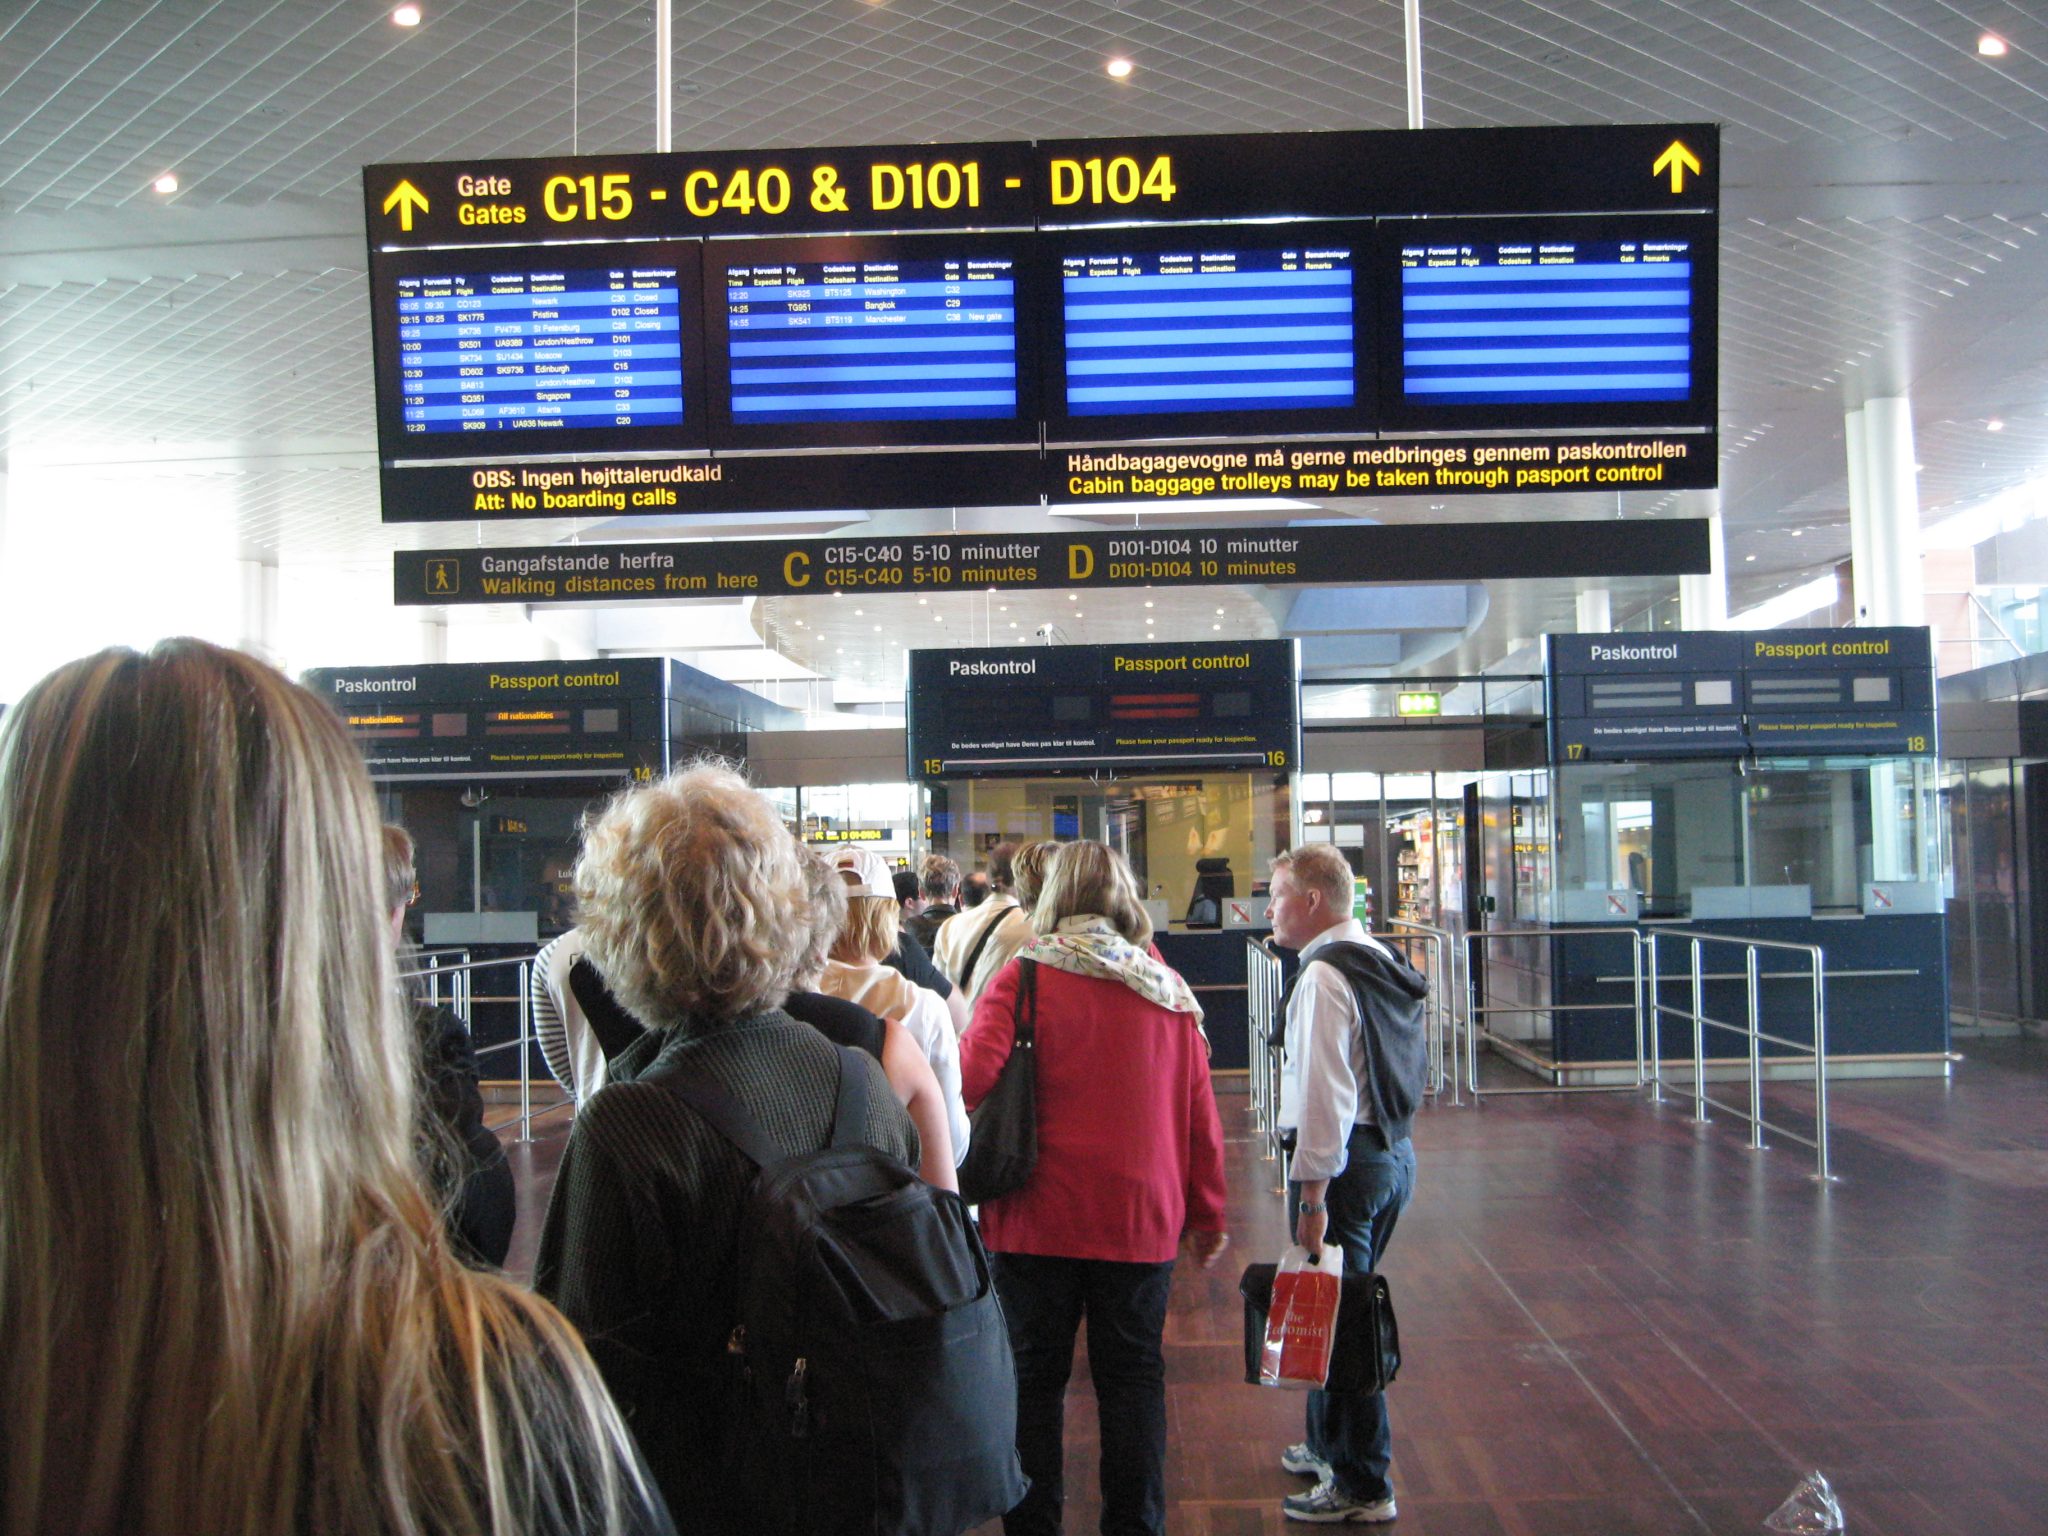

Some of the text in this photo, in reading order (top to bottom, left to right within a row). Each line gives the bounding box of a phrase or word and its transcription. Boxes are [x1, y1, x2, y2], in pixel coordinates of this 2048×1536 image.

[458, 174, 512, 197] Gate
[543, 157, 1175, 223] C15 - C40 & D101 - D104
[460, 202, 526, 226] Gates
[865, 288, 906, 296] Washington
[533, 311, 558, 319] Pristina
[865, 302, 895, 310] Bangkok
[534, 338, 594, 346] London/Heathrow
[535, 365, 570, 374] Edinburgh
[536, 378, 595, 386] London/Heathrow
[537, 393, 570, 401] Singapore
[1069, 442, 1686, 473] Håndbagagevogne må gerne medbringes gennem paskontrollen
[473, 465, 721, 489] OBS: Ingen højttalerudkald
[1070, 464, 1662, 495] Cabin baggage trolleys may be taken through pasport control
[475, 489, 676, 510] Att: No boarding calls
[825, 543, 1039, 564] C15-C40 5-10 minutter
[1109, 538, 1298, 556] D101-D104 10 minutter
[482, 553, 674, 576] Gangafstande herfra
[784, 552, 810, 587] C
[1069, 545, 1094, 579] D
[1110, 560, 1296, 578] D101-D104 10 minutes
[483, 572, 758, 596] Walking distances from here
[825, 566, 1037, 586] C15-C40 5-10 minutes
[1591, 644, 1677, 661] Paskontrol
[1755, 640, 1889, 659] Passport control
[950, 660, 1035, 675] Paskontrol
[1115, 655, 1250, 673] Passport control
[335, 677, 416, 693] Paskontrol
[490, 672, 619, 691] Passport control
[361, 716, 404, 724] nationalities
[510, 712, 554, 720] nationalities
[1567, 744, 1583, 759] 17
[1907, 736, 1925, 751] 18
[924, 759, 941, 774] 15
[1267, 751, 1284, 766] 16
[634, 768, 650, 782] 14
